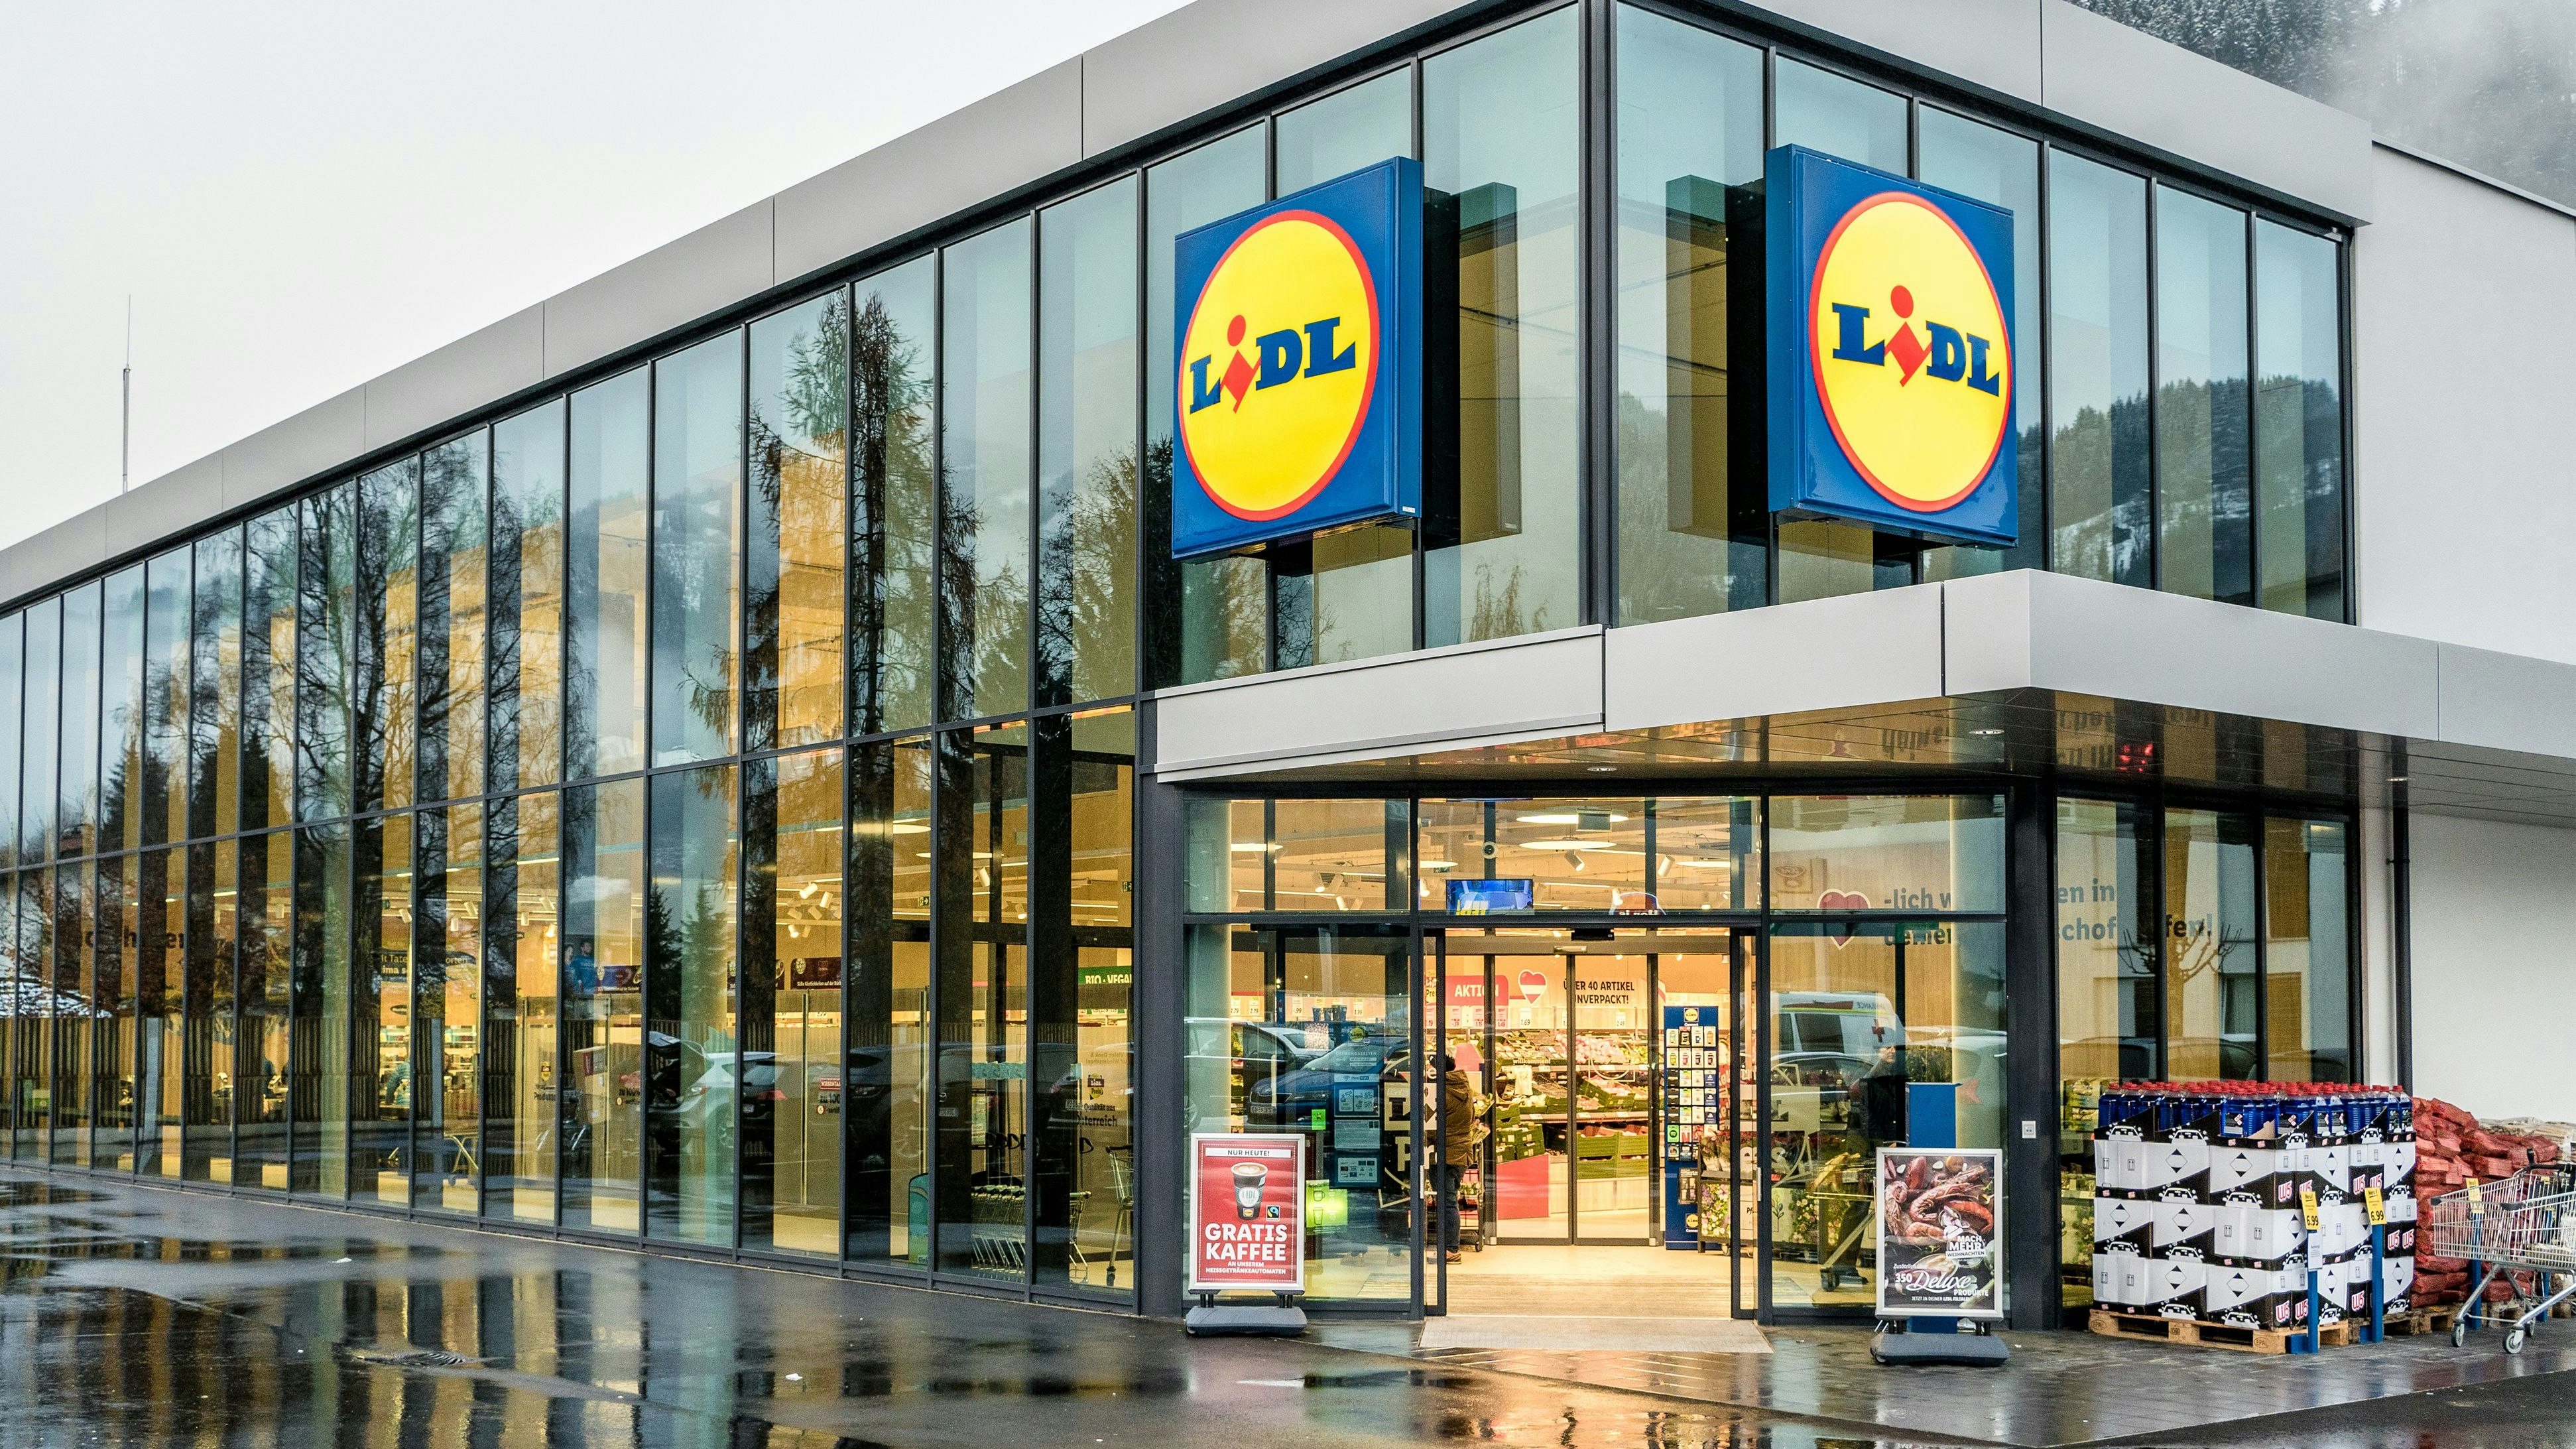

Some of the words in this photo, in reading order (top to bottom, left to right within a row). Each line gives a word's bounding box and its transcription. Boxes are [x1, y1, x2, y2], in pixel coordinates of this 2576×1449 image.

[2092, 878, 2115, 902] in
[1454, 984, 1499, 997] AKTI
[1588, 981, 1598, 991] 40
[1601, 981, 1635, 991] ARTIKEL
[1575, 994, 1629, 1004] NVERPACKT!
[2306, 1216, 2319, 1226] 6.99
[2370, 1210, 2384, 1221] 6.99
[1205, 1223, 1288, 1242] GRATIS
[1206, 1242, 1286, 1261] KAFFEE
[1949, 1241, 1981, 1251] MEHR
[1895, 1273, 1912, 1283] 350
[1906, 1270, 1972, 1293] Deluxe
